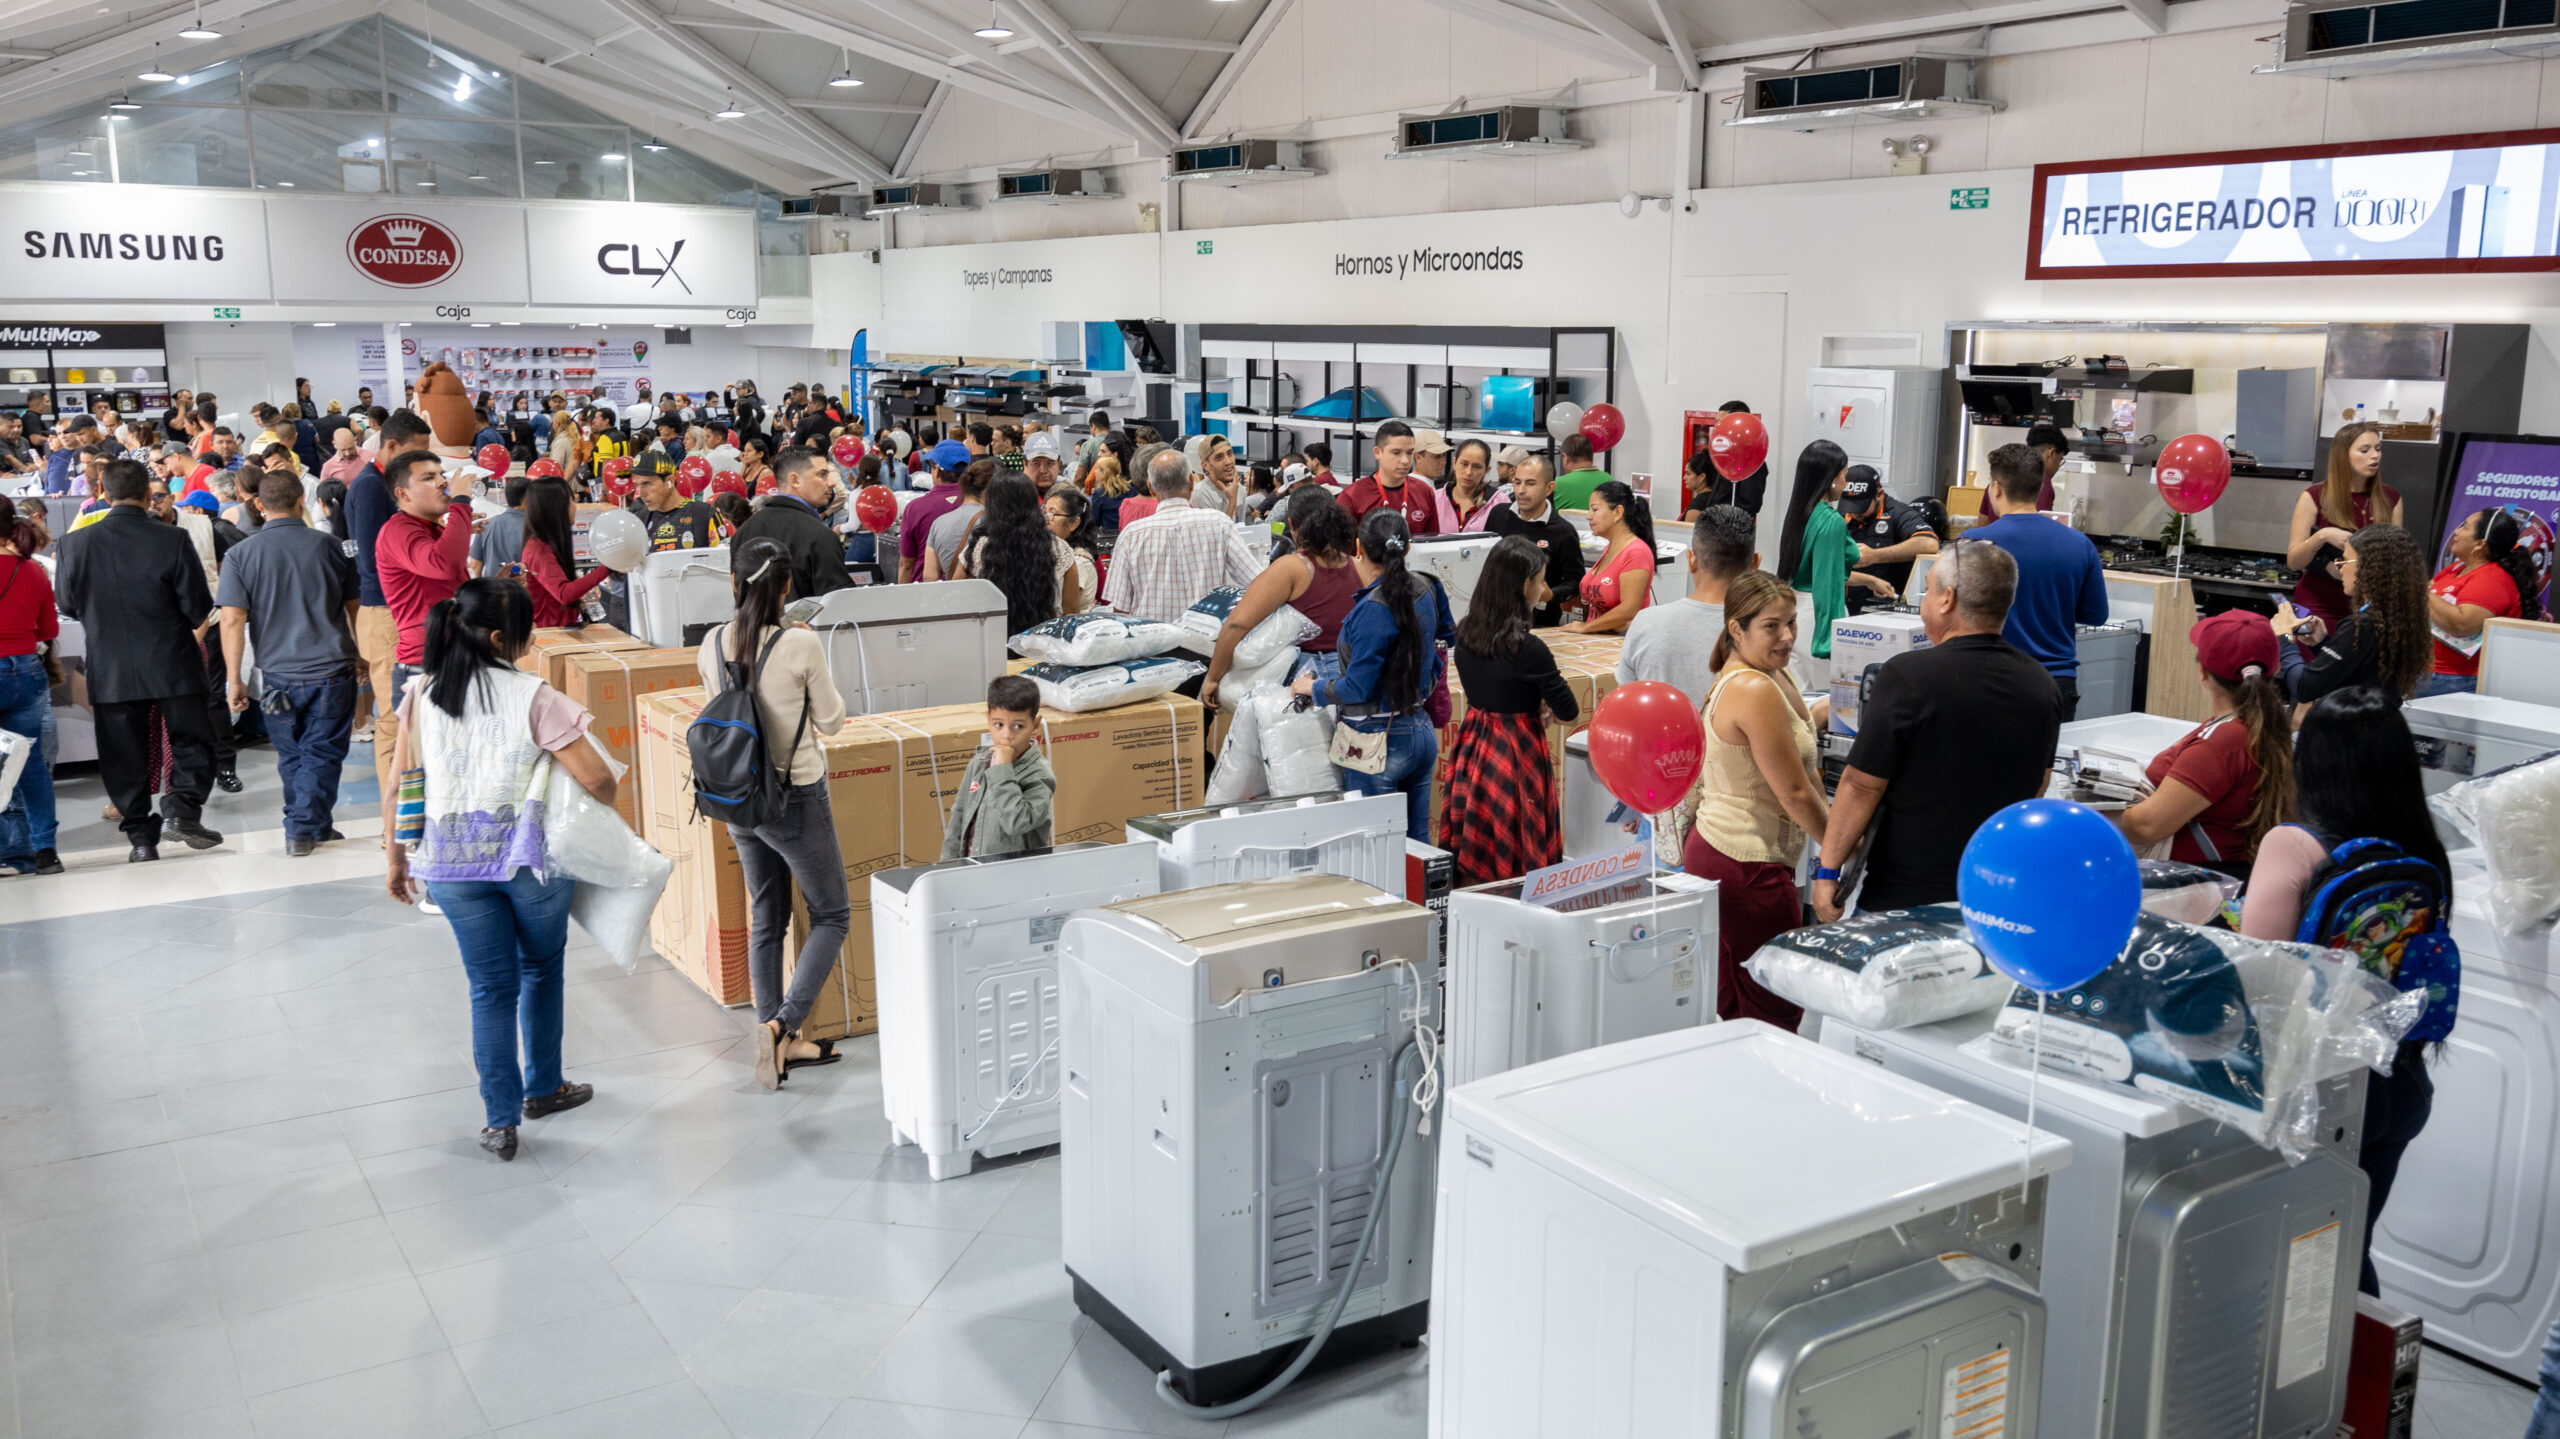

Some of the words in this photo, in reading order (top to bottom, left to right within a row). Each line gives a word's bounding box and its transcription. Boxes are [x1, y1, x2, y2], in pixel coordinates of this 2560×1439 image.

[2062, 196, 2317, 236] REFRIGERADOR
[24, 230, 225, 262] SAMSUNG
[359, 247, 452, 267] CONDESA
[1335, 253, 1394, 276] Hornos
[1397, 253, 1409, 281] y
[1413, 246, 1524, 273] Microondas
[597, 238, 693, 295] CLX
[962, 269, 989, 291] Topes
[990, 270, 997, 291] y
[998, 267, 1053, 289] Campanas
[435, 305, 471, 320] Caja
[726, 307, 757, 323] Caja
[2, 327, 94, 342] MultiMax
[1836, 627, 1884, 642] DAEWOO
[1112, 731, 1142, 741] Lavadora
[1143, 724, 1198, 737] Semi-Autmática
[906, 757, 940, 767] Lavadoa
[1132, 759, 1170, 771] Capacidad
[1425, 896, 1449, 910] FHD
[2395, 1341, 2420, 1365] HD
